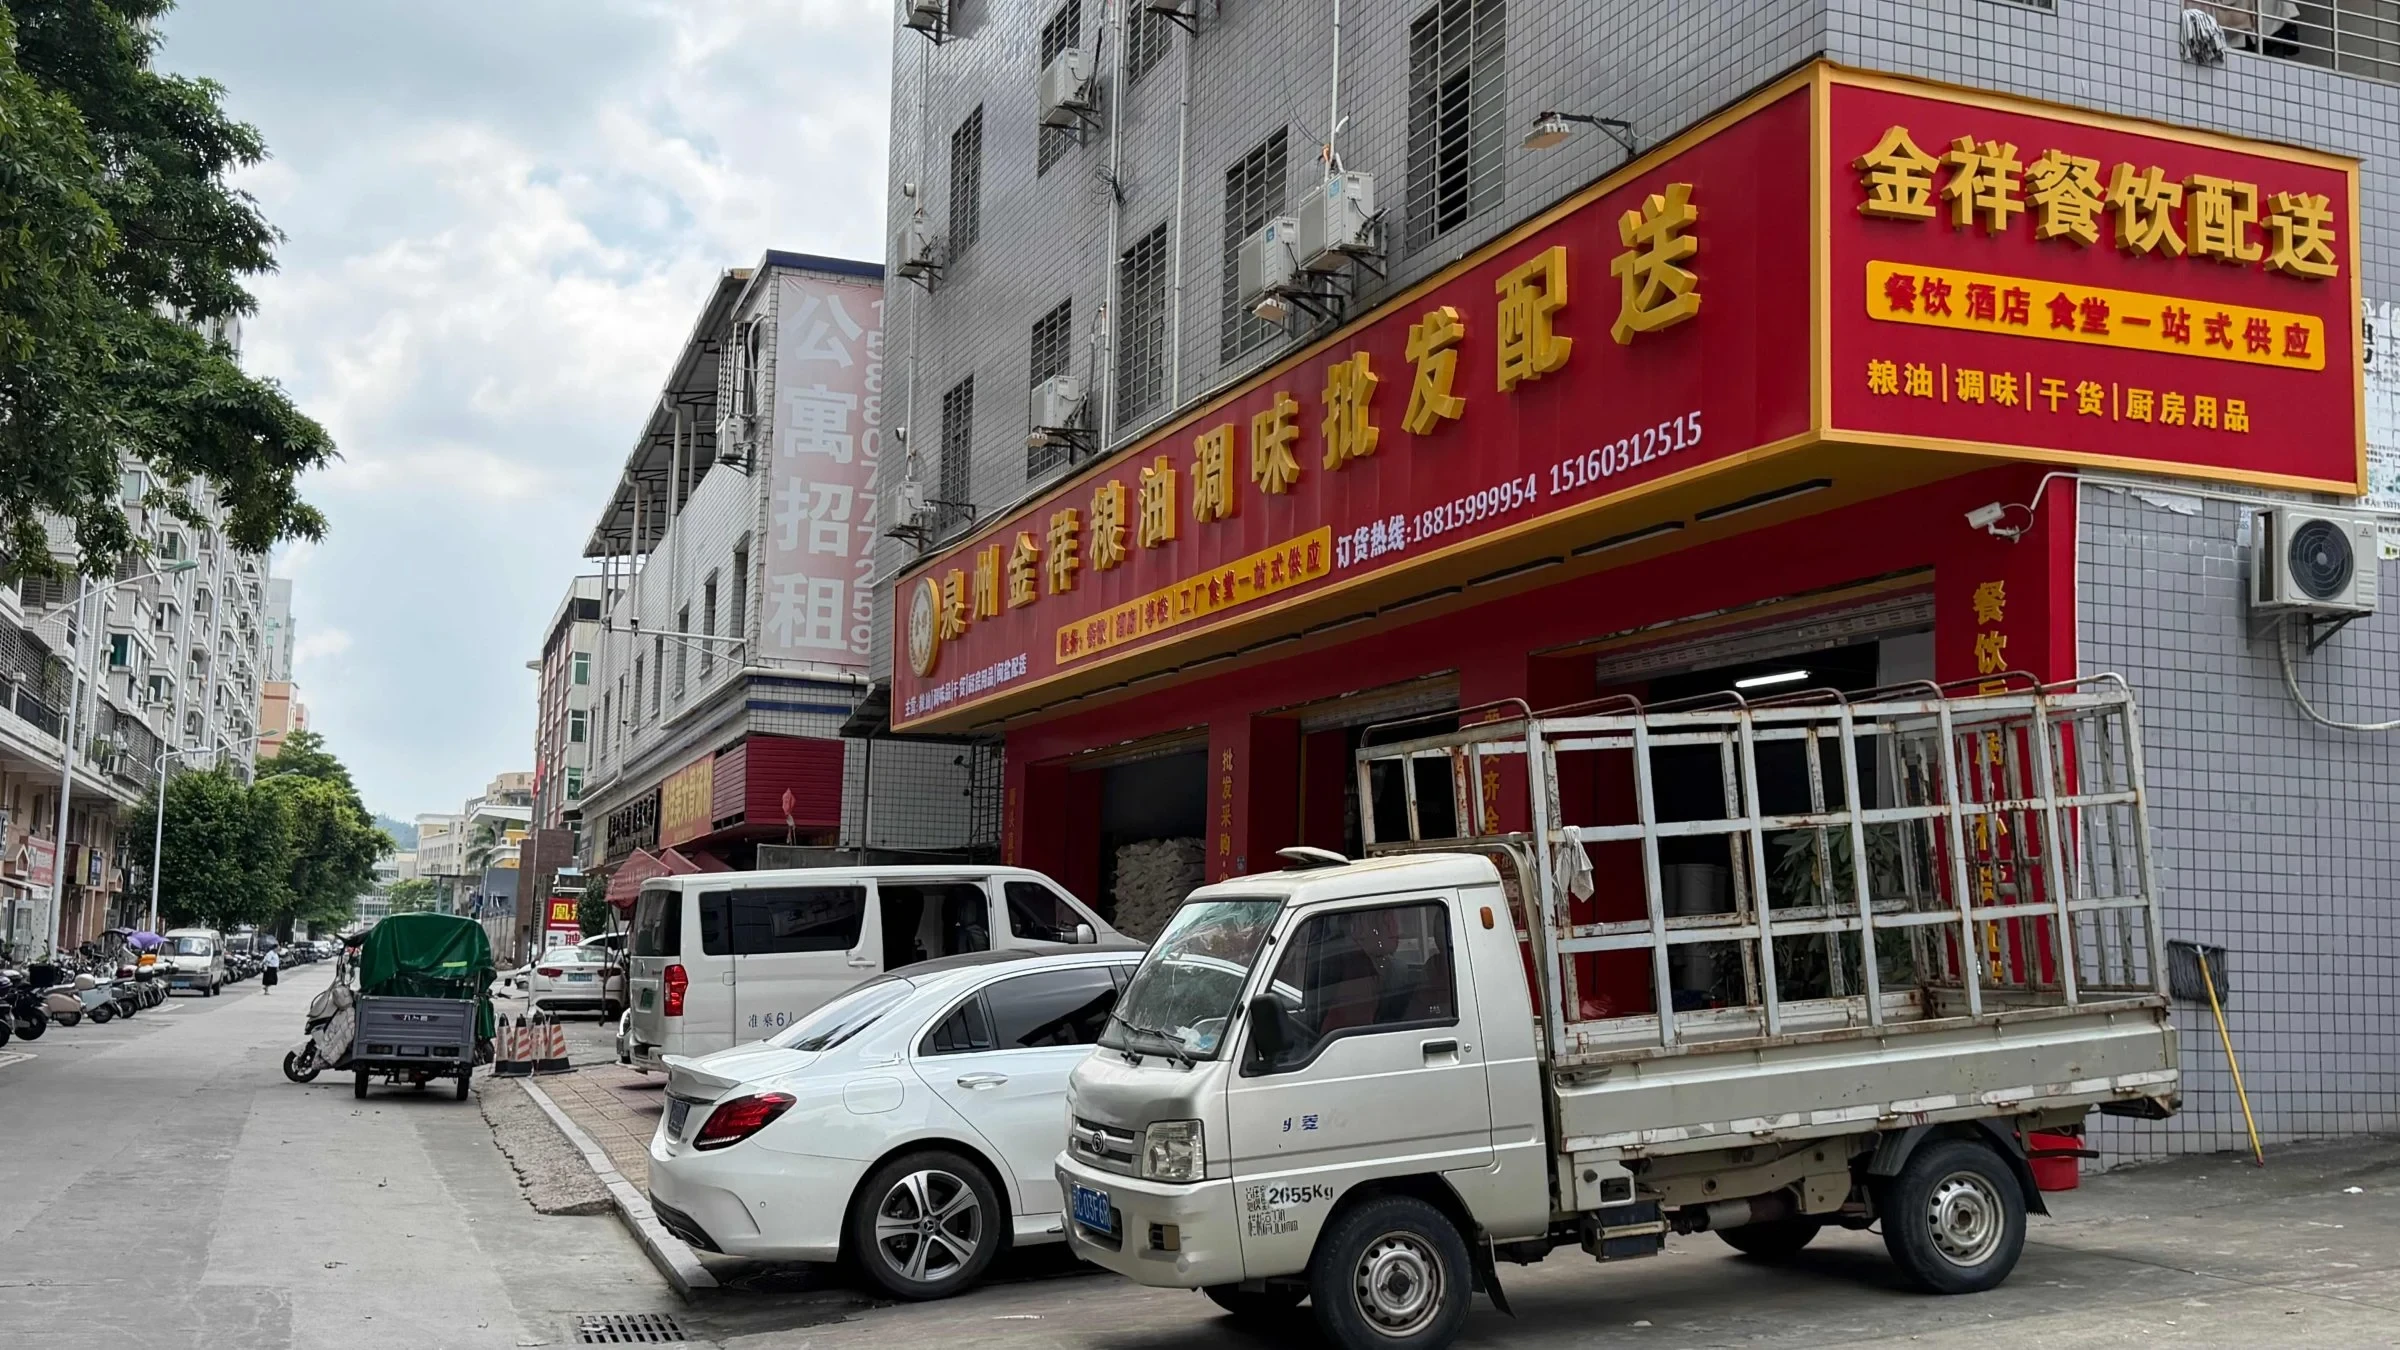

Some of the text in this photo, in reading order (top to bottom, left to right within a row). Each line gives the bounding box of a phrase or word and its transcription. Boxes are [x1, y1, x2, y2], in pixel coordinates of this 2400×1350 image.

[1853, 125, 2339, 279] 金祥餐饮配送
[1884, 272, 1953, 318] 餐饮
[1965, 282, 2031, 327] 酒店
[767, 294, 863, 651] 公寓招租
[940, 183, 1702, 641] 泉州金祥粮油调味批发配送
[1549, 410, 1702, 496] 15160312515
